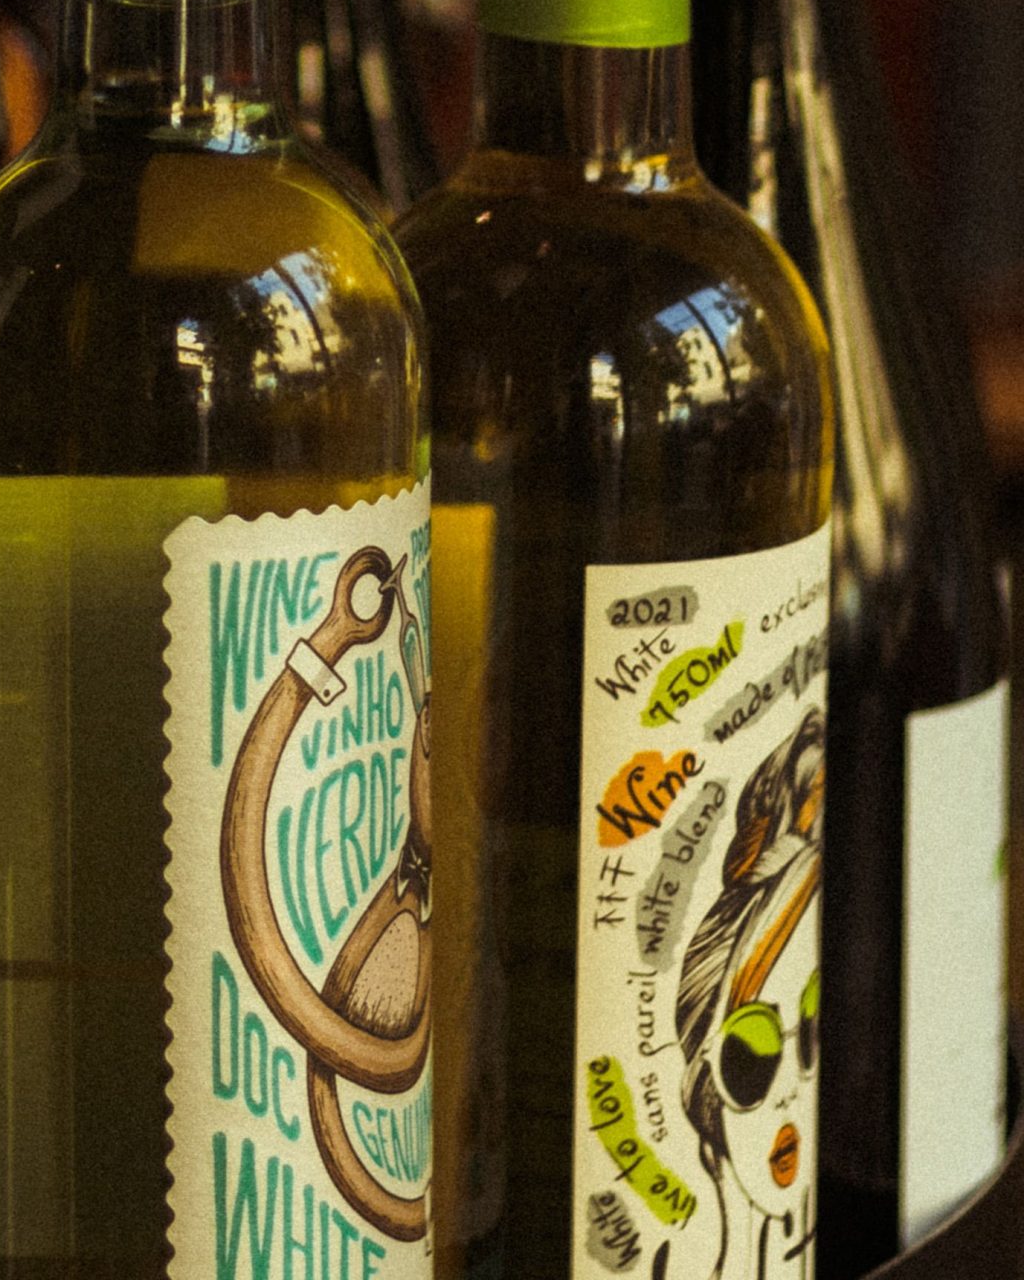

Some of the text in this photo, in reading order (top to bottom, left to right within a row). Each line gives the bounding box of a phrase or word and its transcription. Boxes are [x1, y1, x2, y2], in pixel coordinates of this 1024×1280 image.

[209, 551, 339, 768] WINE
[595, 627, 676, 701] White
[610, 596, 689, 626] 2021
[648, 625, 739, 724] 750ml
[300, 650, 404, 770] VINHO
[713, 681, 775, 745] made
[277, 748, 407, 965] VERDE
[596, 751, 705, 840] Wine
[636, 780, 726, 955] white blend
[212, 950, 300, 1142] DOC
[626, 969, 677, 1143] sans pareil
[212, 1131, 387, 1280] WHITE
[588, 1054, 697, 1231] live to love
[588, 1189, 642, 1270] White
